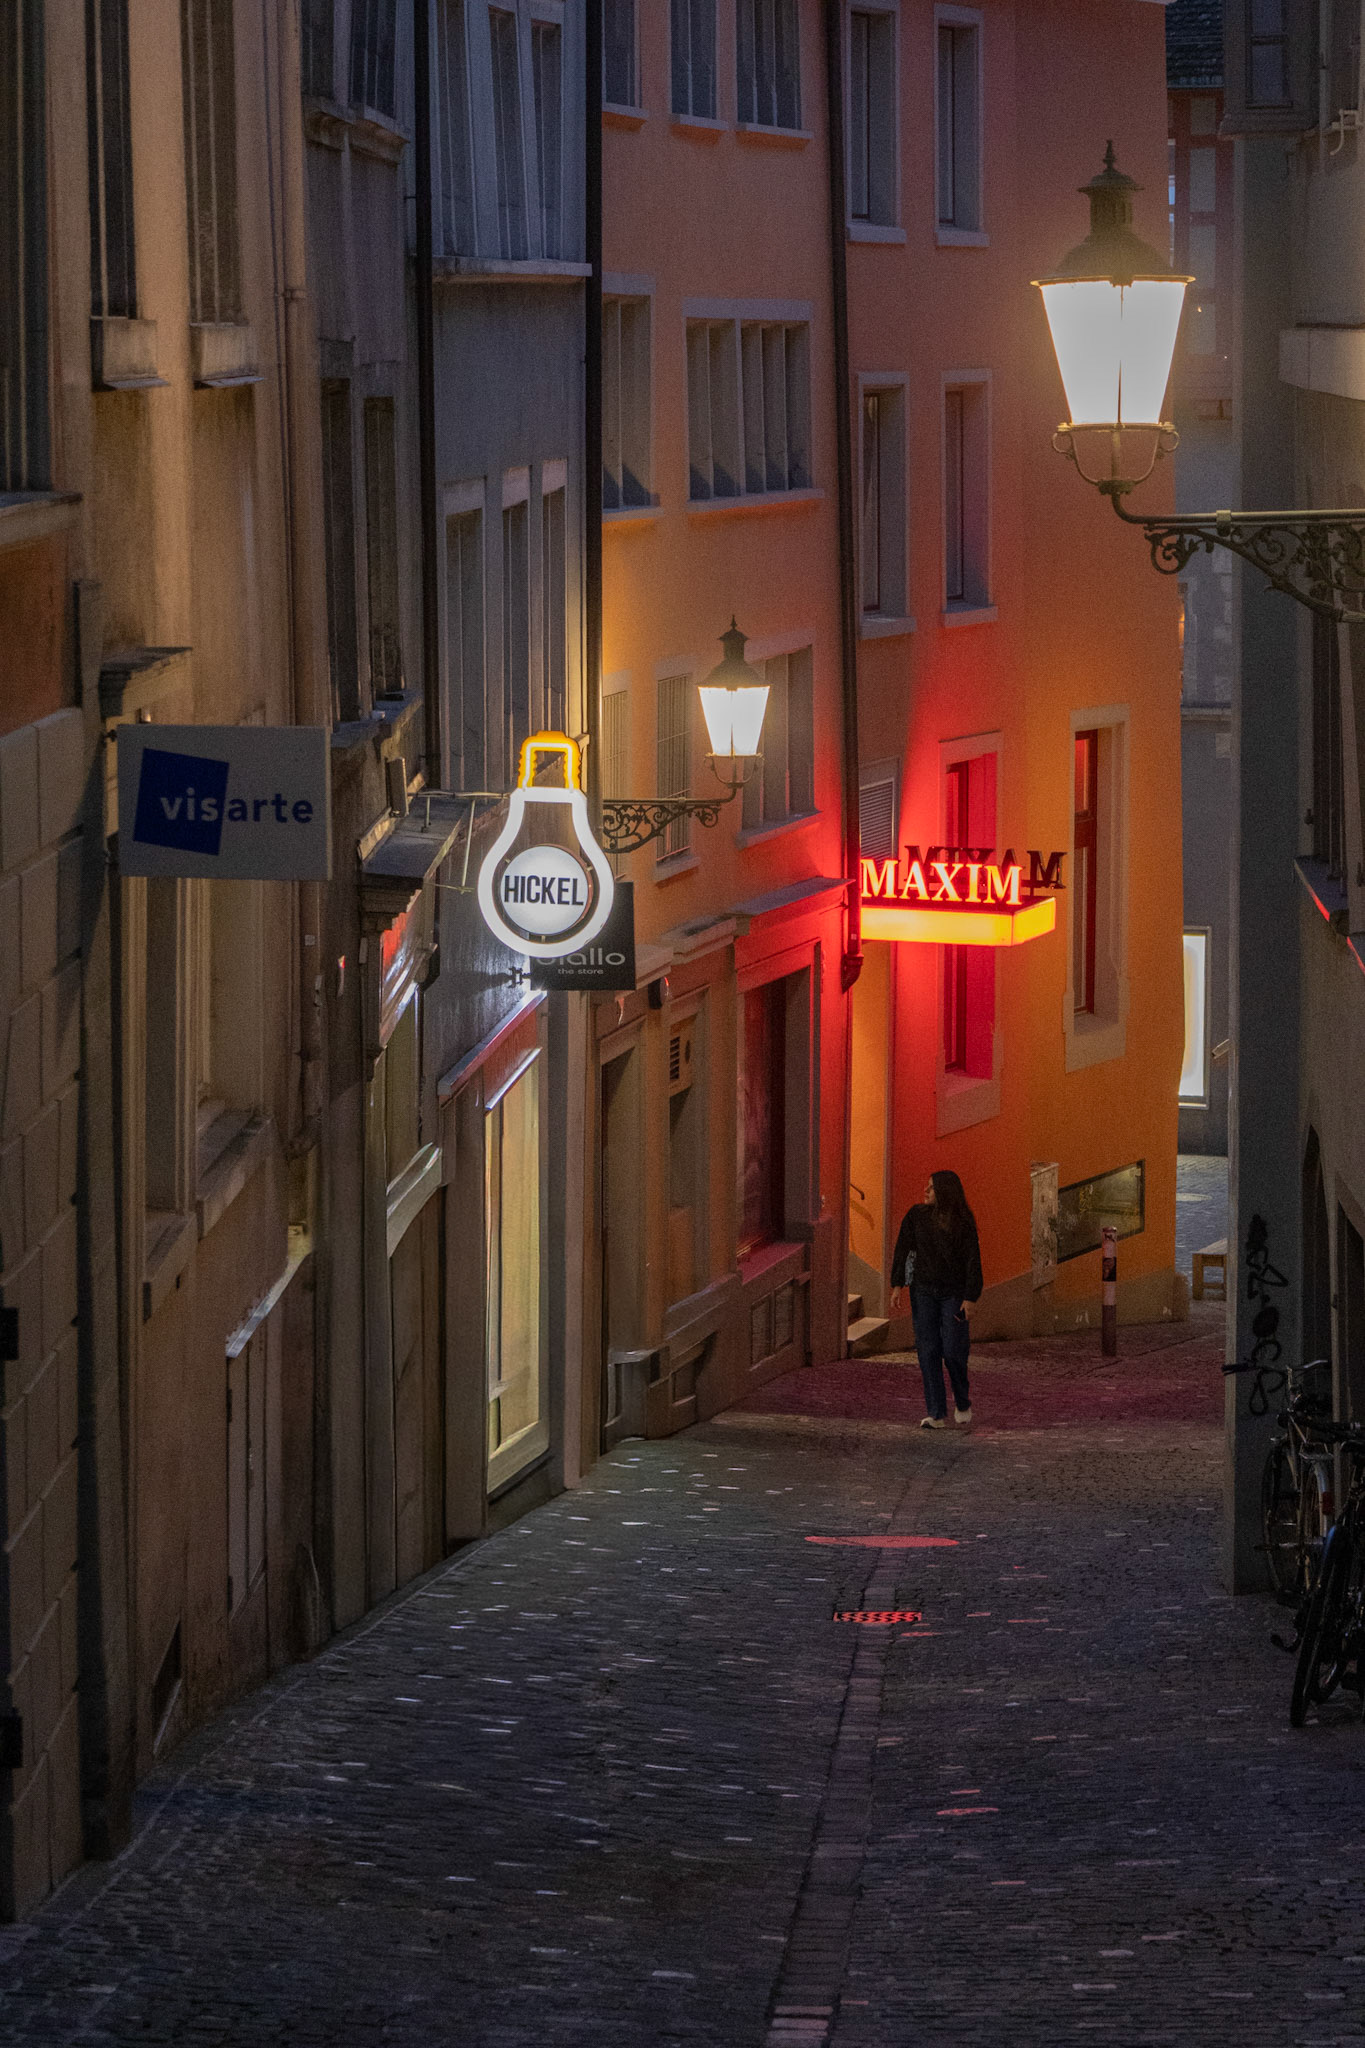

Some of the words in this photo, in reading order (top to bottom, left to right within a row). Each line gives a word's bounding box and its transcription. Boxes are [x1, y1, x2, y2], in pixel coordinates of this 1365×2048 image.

[160, 787, 314, 824] visarte
[504, 874, 584, 906] HICKEL
[860, 859, 1023, 905] MAXIM
